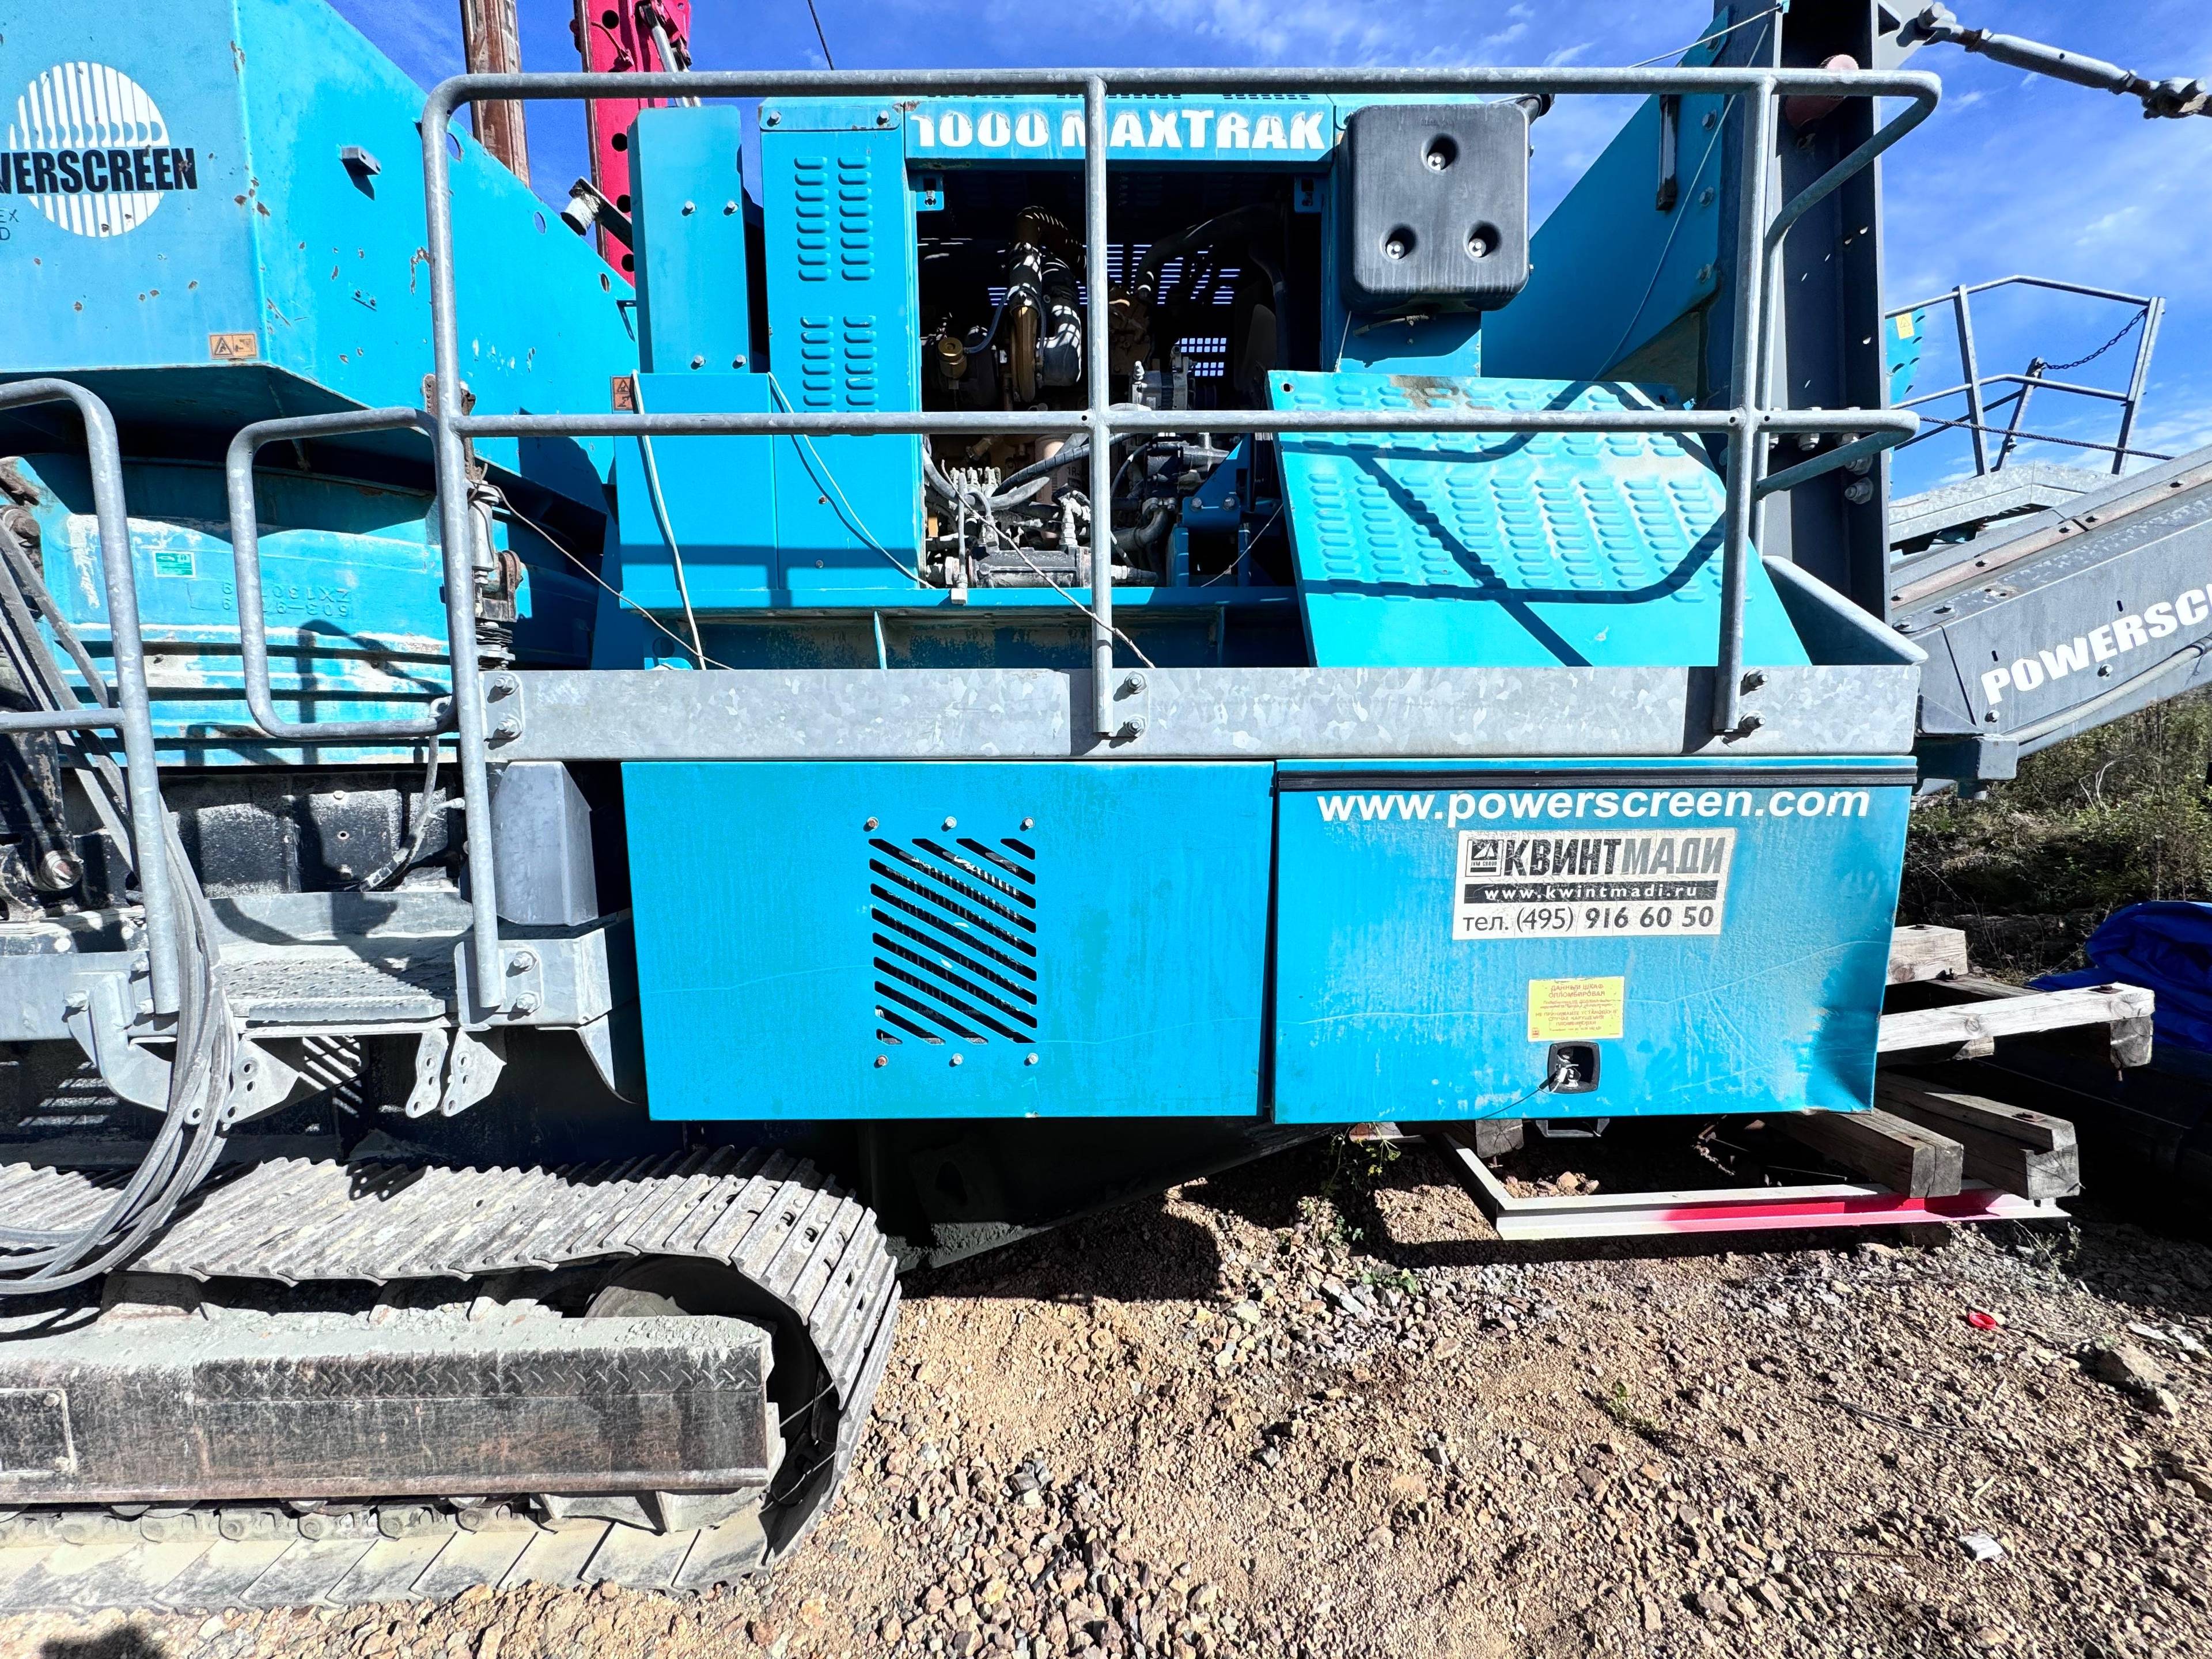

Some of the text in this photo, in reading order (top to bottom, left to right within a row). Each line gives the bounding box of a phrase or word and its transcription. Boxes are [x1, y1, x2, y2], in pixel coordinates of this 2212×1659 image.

[910, 111, 1049, 147] 1000
[1316, 789, 1870, 828] www.powerscreen.com
[1503, 837, 1726, 876] КВИНТМАДИ
[1484, 884, 1698, 900] www.kwintmadi.ru
[1463, 906, 1714, 932] тел. (495) 916 60 50
